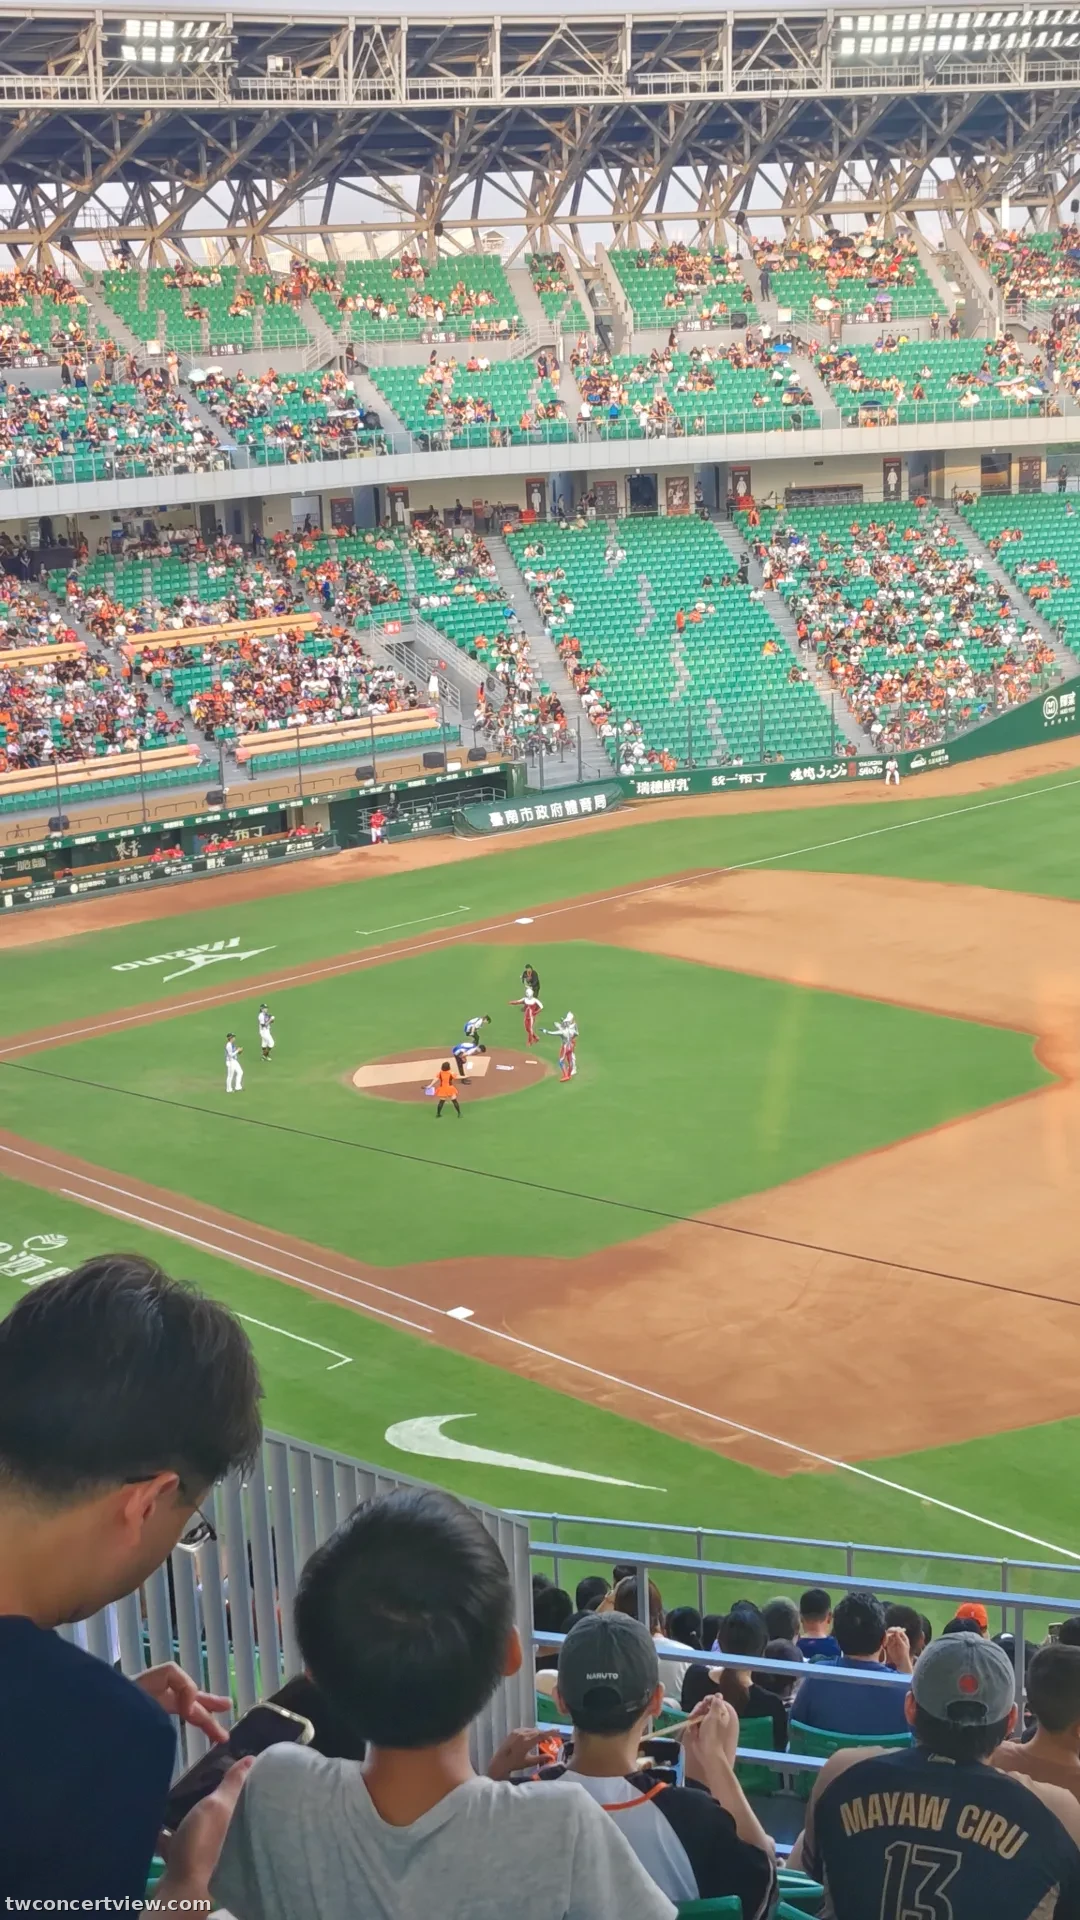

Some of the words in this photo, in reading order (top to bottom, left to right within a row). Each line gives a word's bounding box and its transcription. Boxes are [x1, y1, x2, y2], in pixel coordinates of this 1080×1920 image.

[489, 794, 607, 827] 臺南市政府體育局
[586, 1672, 619, 1680] NARUTO
[839, 1791, 951, 1837] MAYAW
[955, 1804, 1030, 1860] CIRU
[880, 1840, 963, 1920] 13
